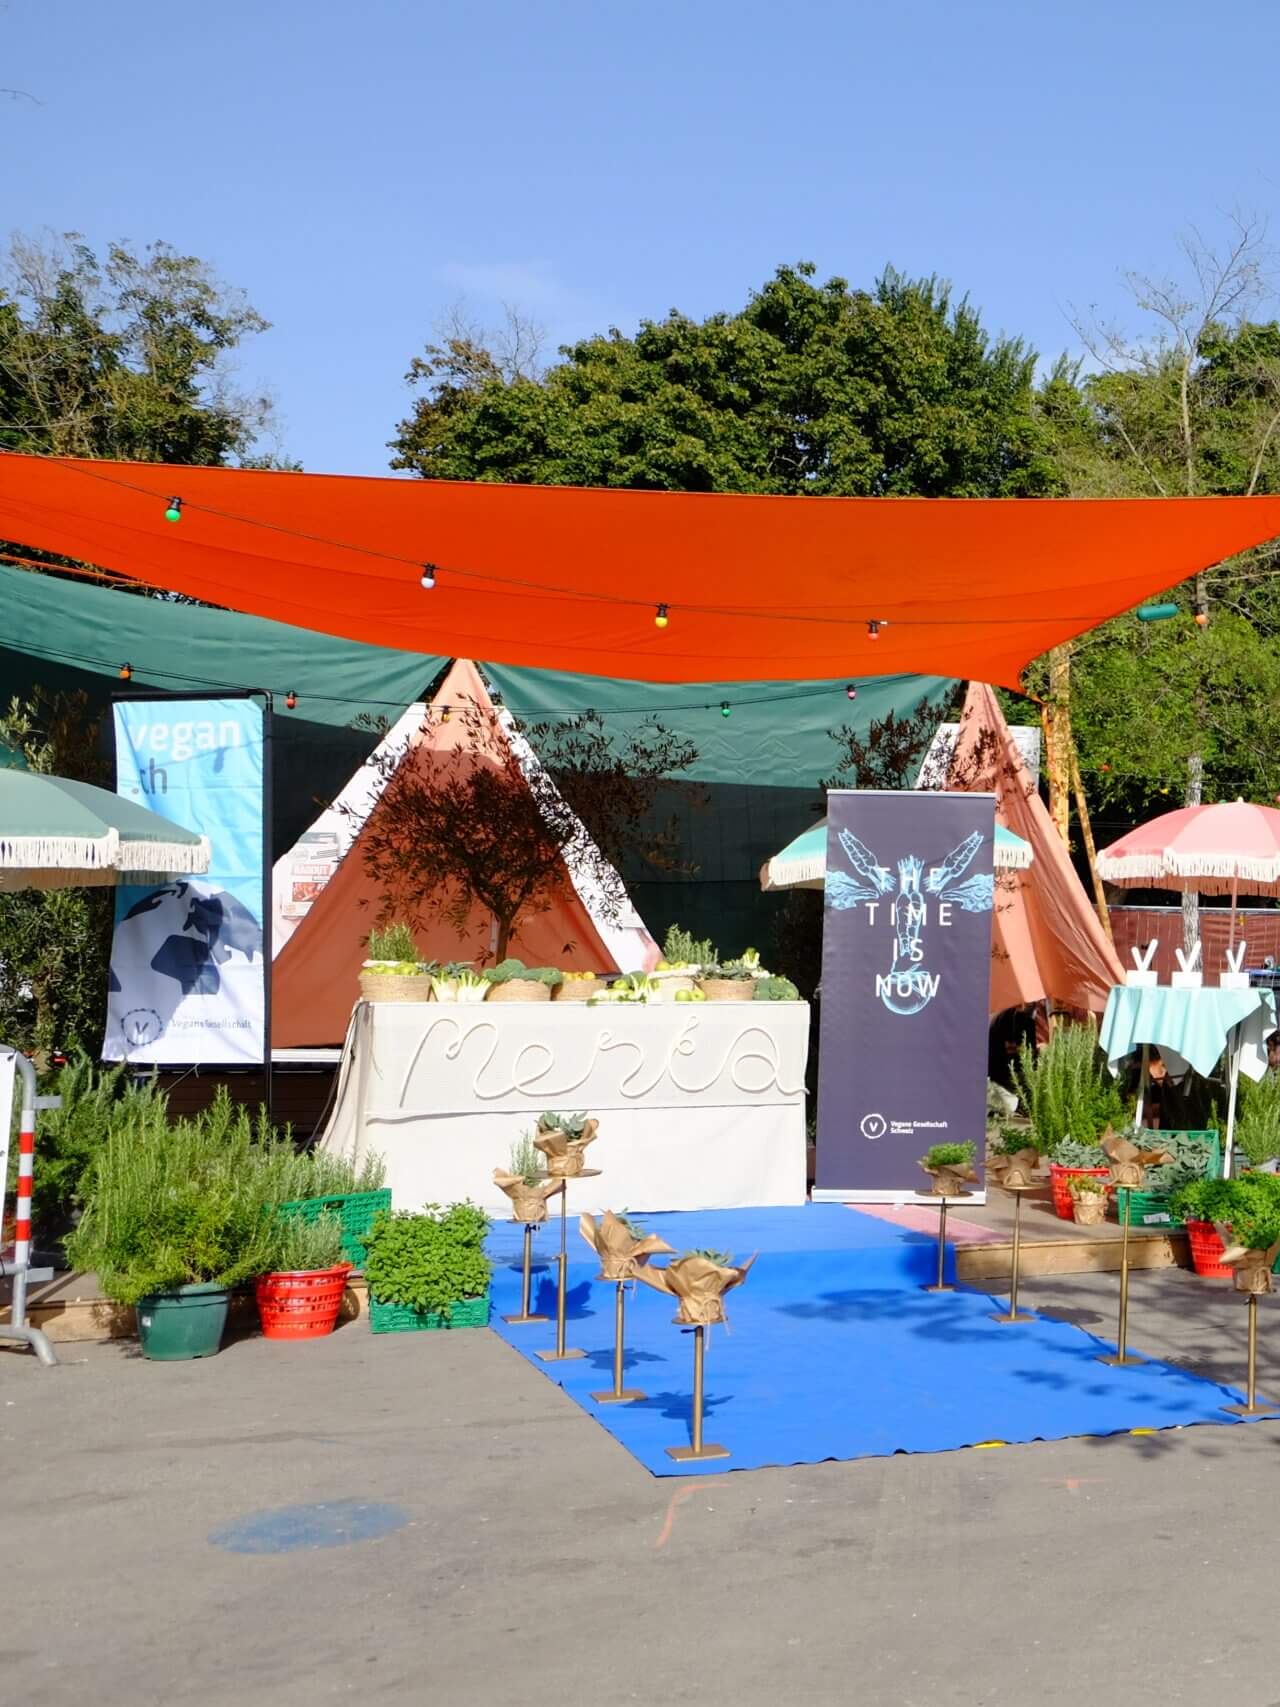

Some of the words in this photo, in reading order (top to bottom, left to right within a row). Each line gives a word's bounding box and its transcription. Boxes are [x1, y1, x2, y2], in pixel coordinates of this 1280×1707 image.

[129, 719, 240, 761] vegan
[131, 757, 168, 795] .ch
[876, 867, 943, 891] THE
[864, 902, 953, 927] TIME
[893, 938, 925, 962] IS
[875, 973, 941, 998] NOW
